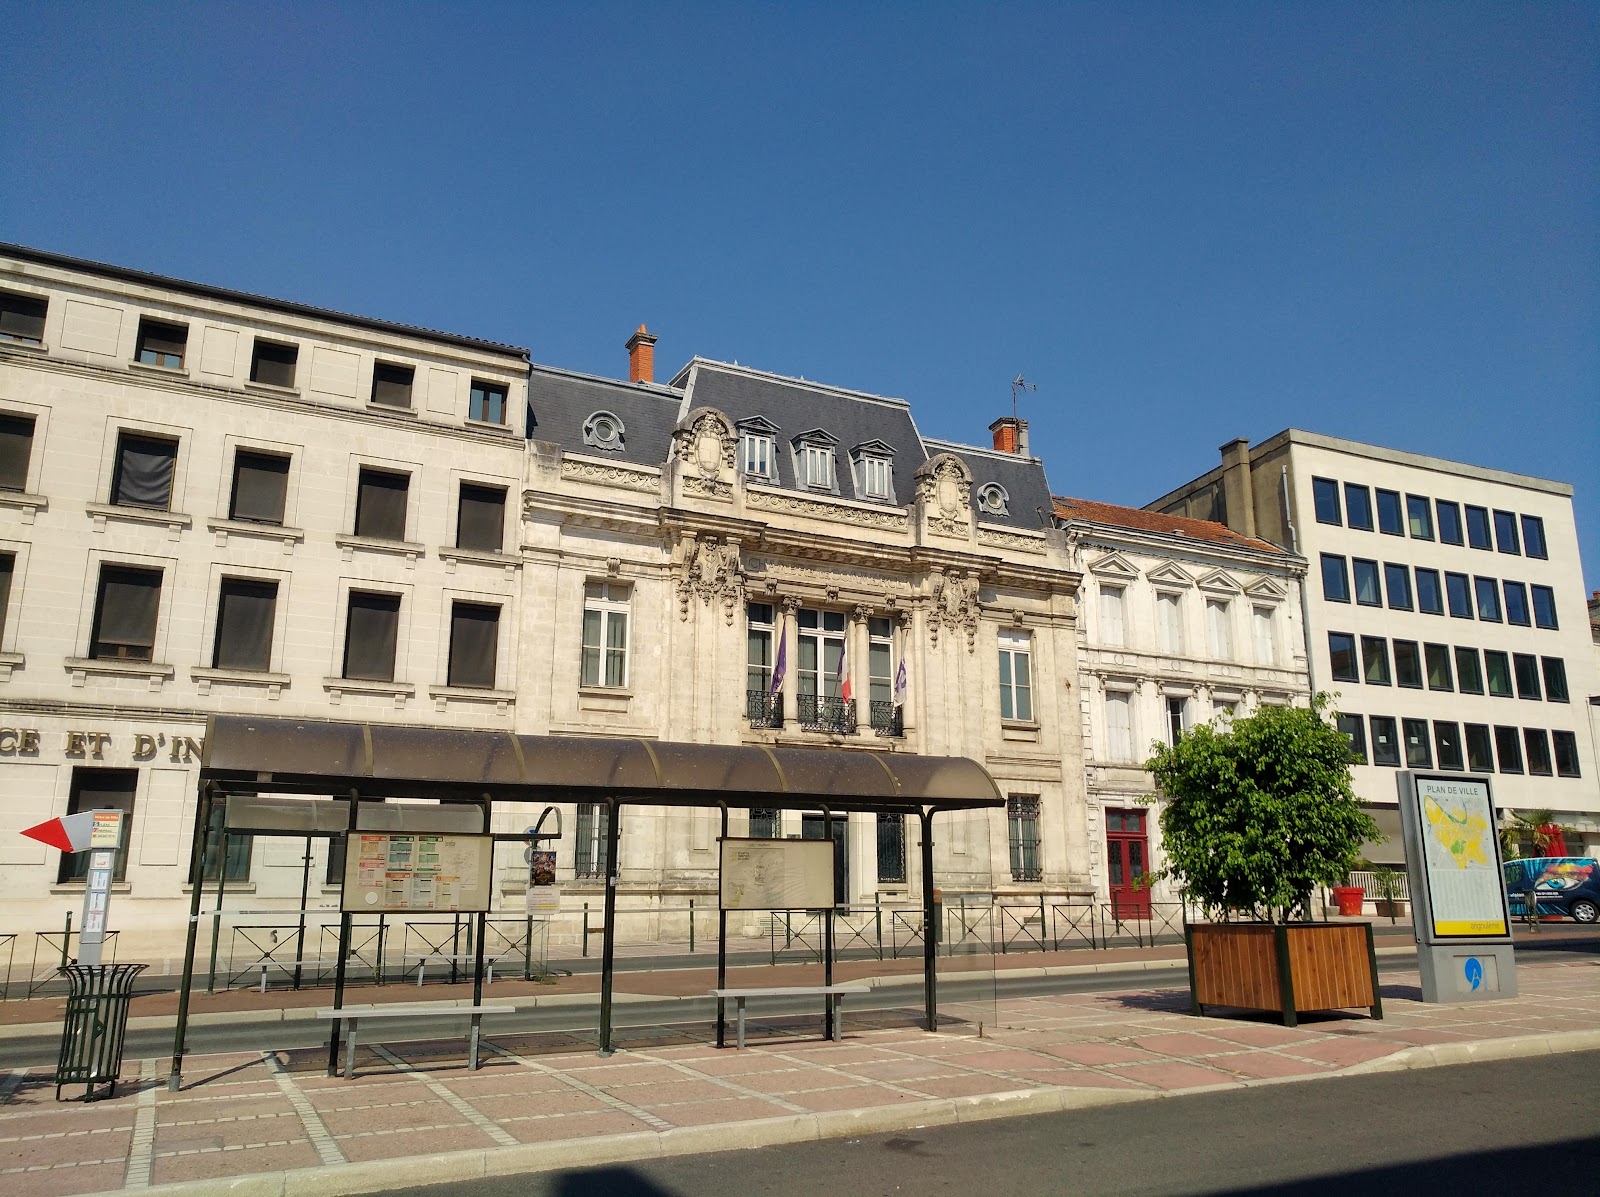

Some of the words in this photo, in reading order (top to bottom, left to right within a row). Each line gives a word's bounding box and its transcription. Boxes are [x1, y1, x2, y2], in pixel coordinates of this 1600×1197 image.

[65, 730, 110, 754] ET
[1427, 785, 1446, 794] PLAN
[1448, 786, 1458, 795] DE
[1459, 787, 1479, 796] VILLE
